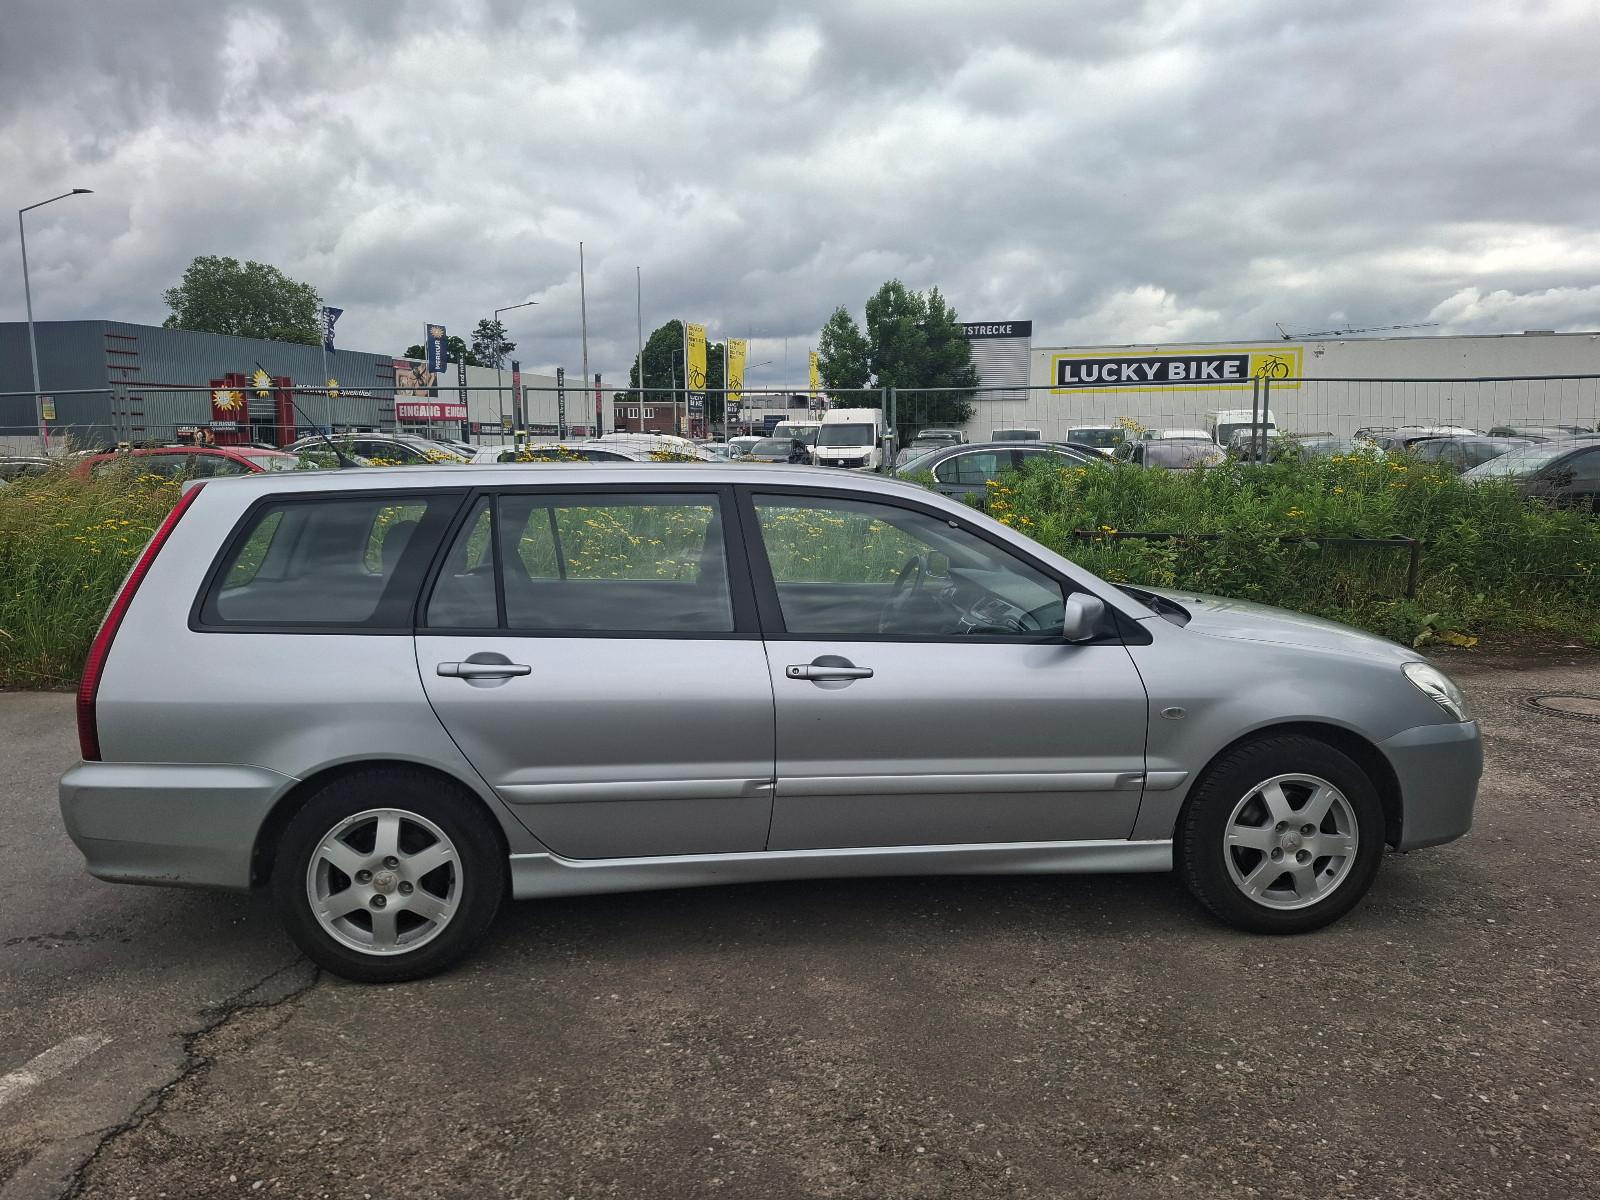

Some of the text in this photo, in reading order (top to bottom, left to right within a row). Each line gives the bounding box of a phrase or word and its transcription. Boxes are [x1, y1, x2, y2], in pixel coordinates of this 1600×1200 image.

[962, 324, 1013, 336] TSTRECKE
[1064, 360, 1241, 383] LUCKY BIKE
[399, 405, 441, 417] EINGANG
